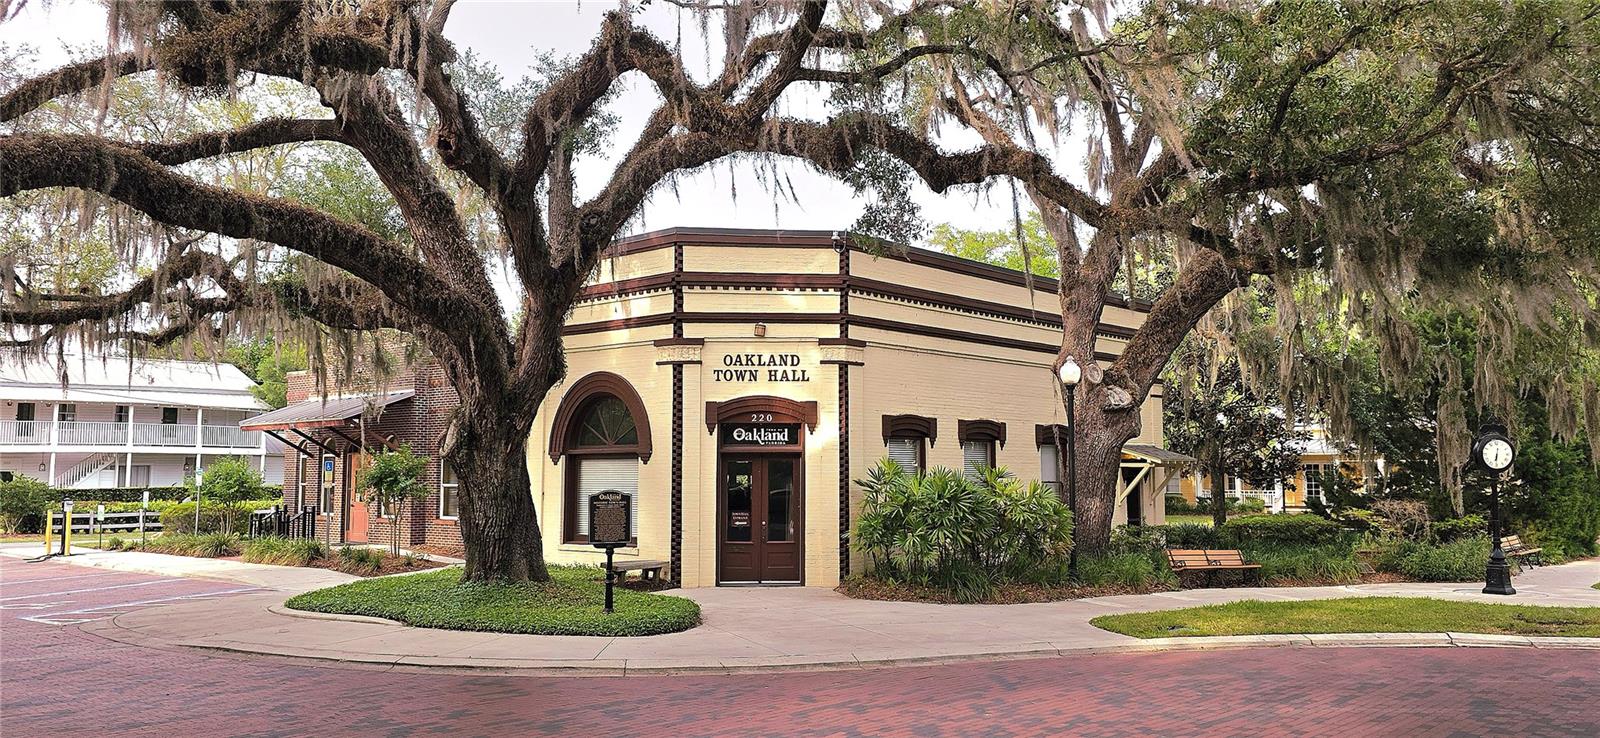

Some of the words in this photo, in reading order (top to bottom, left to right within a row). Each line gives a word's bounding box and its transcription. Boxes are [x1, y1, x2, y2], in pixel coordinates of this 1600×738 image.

[723, 354, 800, 367] OAKLAND
[713, 369, 759, 382] TOWN
[767, 369, 810, 382] HALL
[751, 413, 773, 422] 220
[733, 427, 789, 445] Oakland
